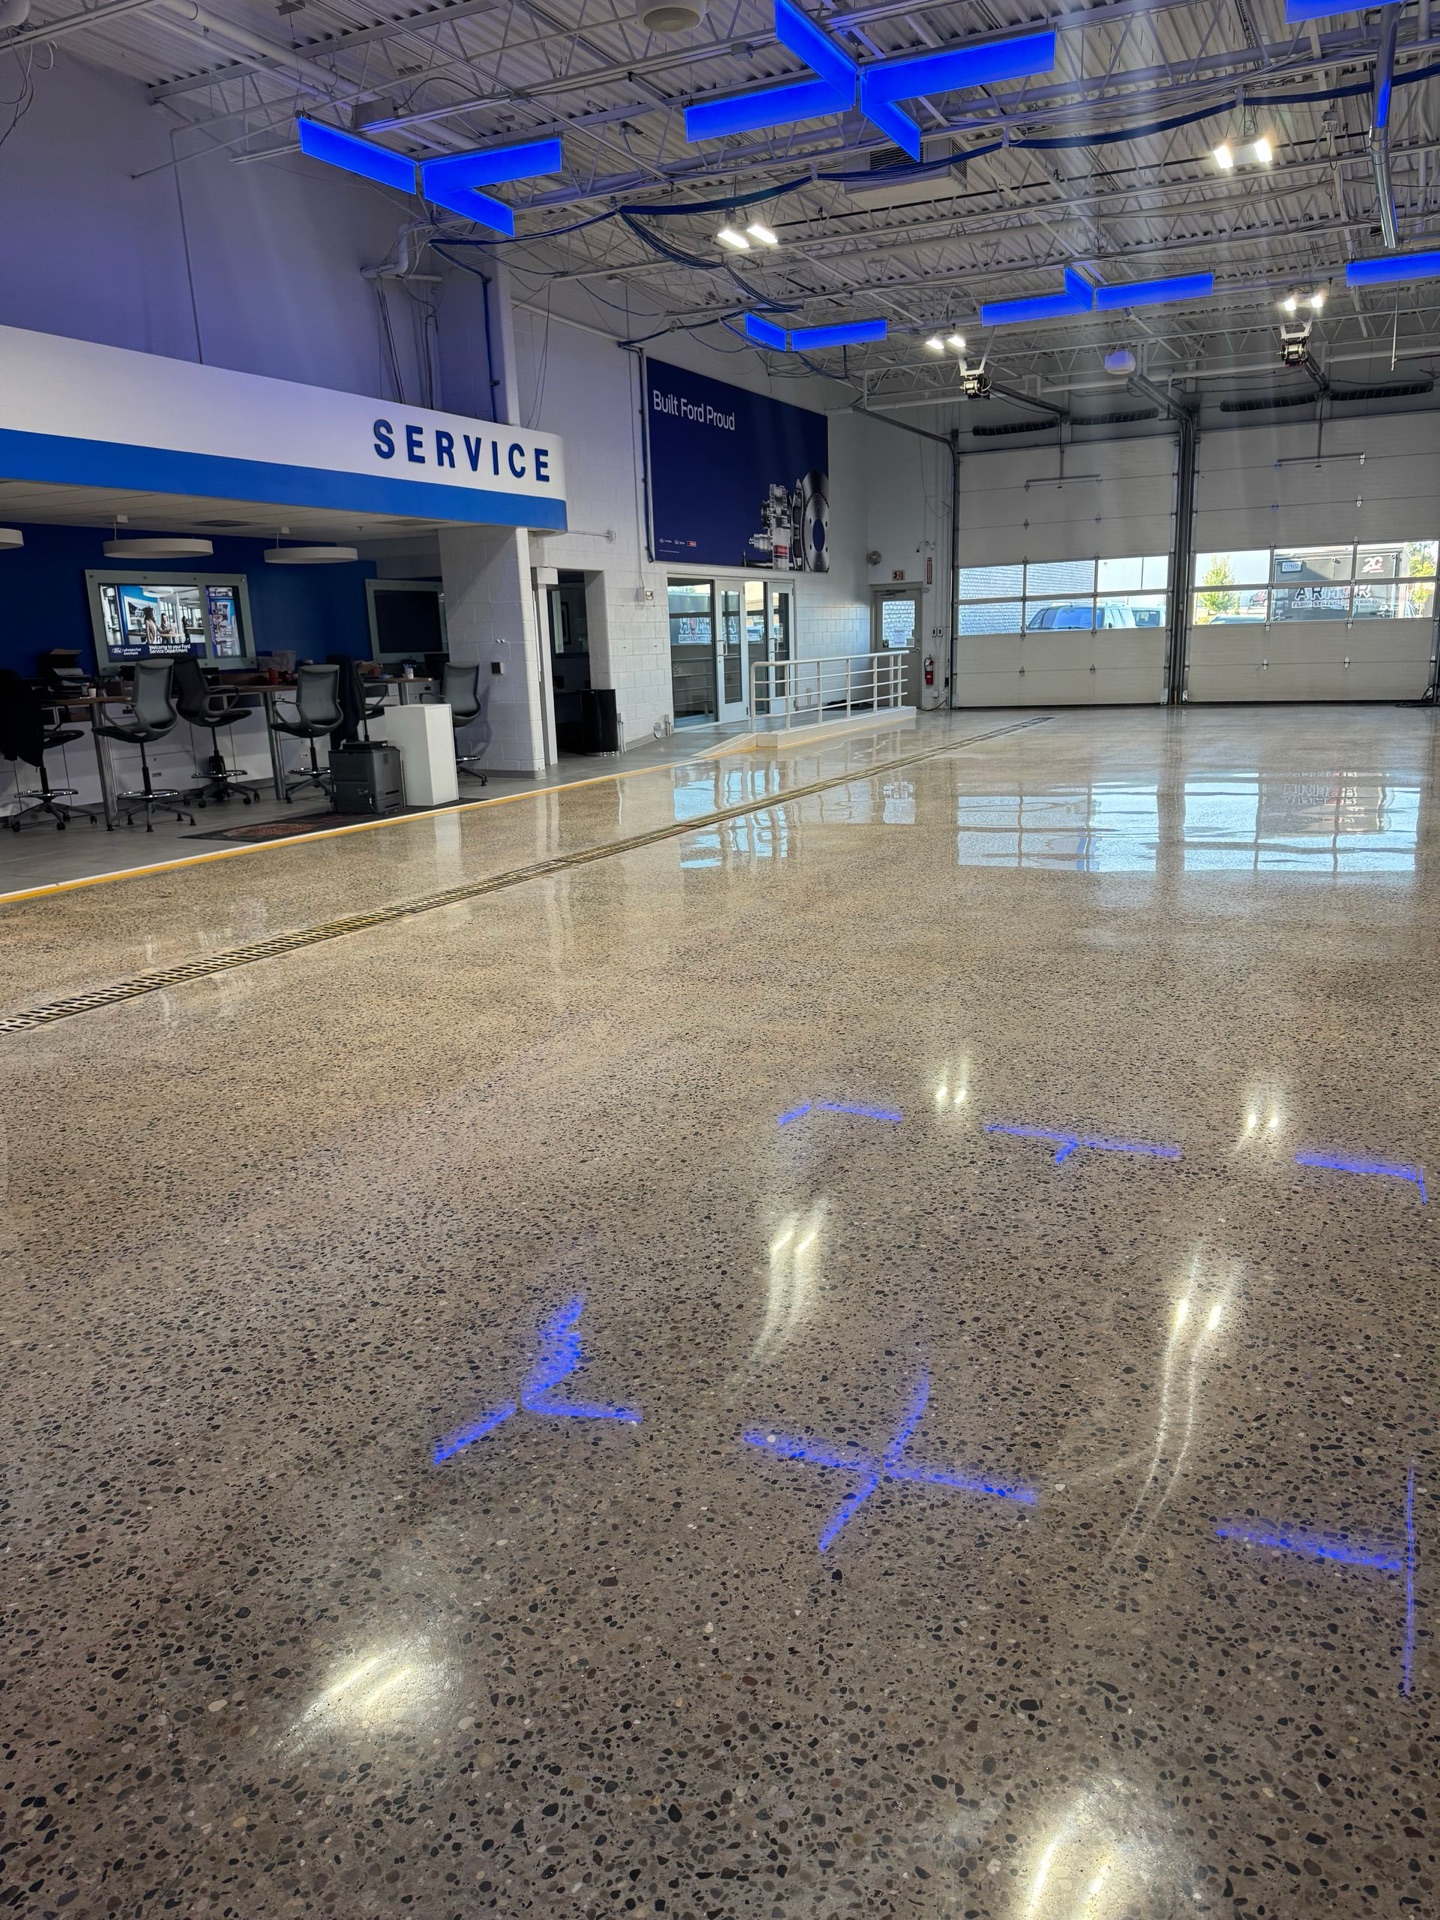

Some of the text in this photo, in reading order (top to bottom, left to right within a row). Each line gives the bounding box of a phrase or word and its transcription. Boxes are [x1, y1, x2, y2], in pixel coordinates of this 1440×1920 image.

[652, 389, 736, 431] Built Ford Proud
[373, 418, 550, 482] SERVICE
